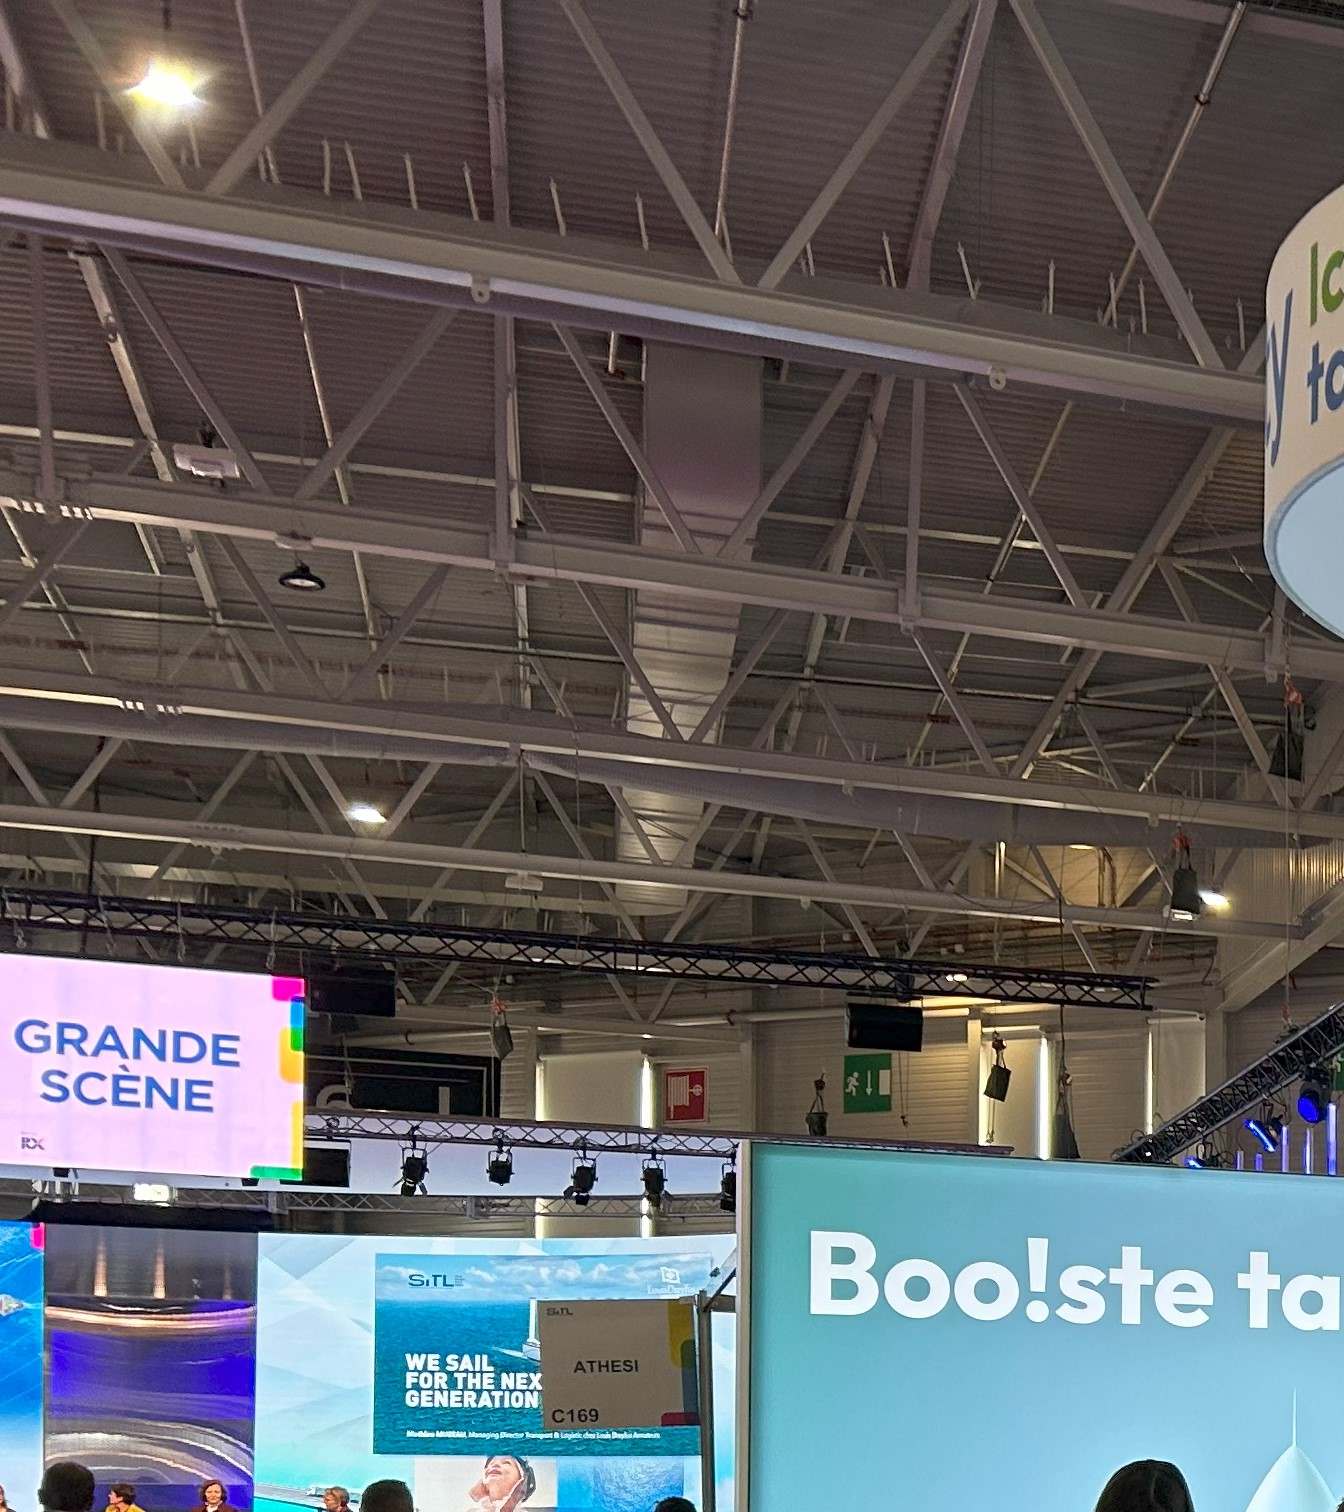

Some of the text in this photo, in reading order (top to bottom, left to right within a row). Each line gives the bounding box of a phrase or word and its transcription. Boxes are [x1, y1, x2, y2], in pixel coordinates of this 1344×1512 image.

[14, 1018, 241, 1068] GRANDE
[40, 1064, 214, 1113] SCÈNE
[809, 1229, 1214, 1328] Boo!ste
[1237, 1251, 1340, 1331] ta
[405, 1353, 495, 1373] WE SAIL
[573, 1359, 639, 1374] ATHESI
[405, 1372, 543, 1391] FOR THE NEX
[405, 1390, 540, 1409] GENERATION
[551, 1408, 600, 1424] C169
